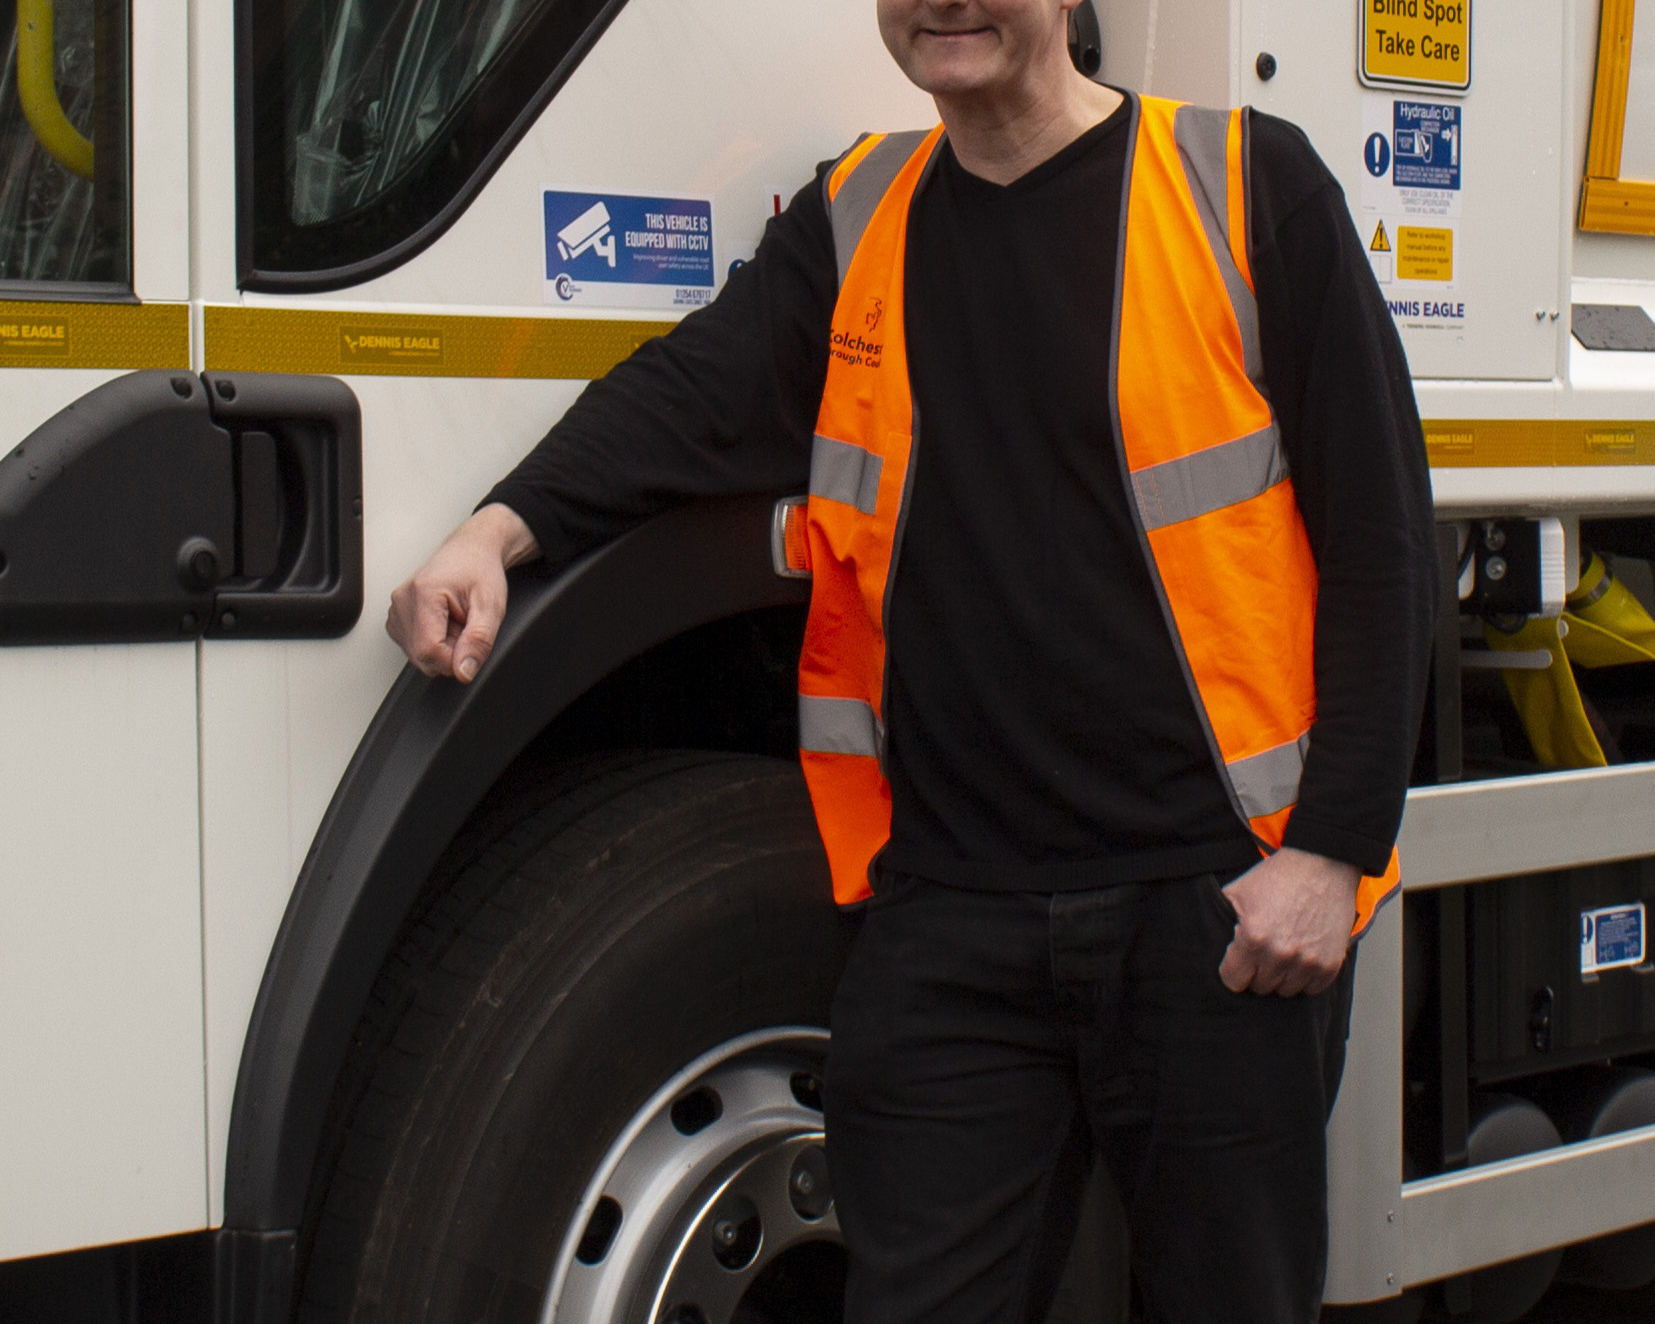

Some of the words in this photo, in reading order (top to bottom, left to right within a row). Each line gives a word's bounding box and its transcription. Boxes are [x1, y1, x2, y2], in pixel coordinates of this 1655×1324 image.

[1375, 29, 1416, 57] Take
[1420, 34, 1461, 62] Care
[1400, 103, 1442, 121] Hydraulic
[1442, 106, 1456, 121] Oil
[645, 213, 664, 229] THIS
[665, 214, 699, 232] VEHICLE
[700, 216, 708, 232] IS
[625, 231, 665, 249] EQUIPPED
[666, 233, 687, 249] WITH
[688, 234, 709, 251] CCTV
[1387, 301, 1420, 316] NNIS
[1423, 301, 1465, 318] EAGLE
[21, 325, 65, 339] EAGLE
[359, 335, 401, 348] DENNIS
[403, 337, 440, 350] EAGLE
[831, 349, 862, 365] rough
